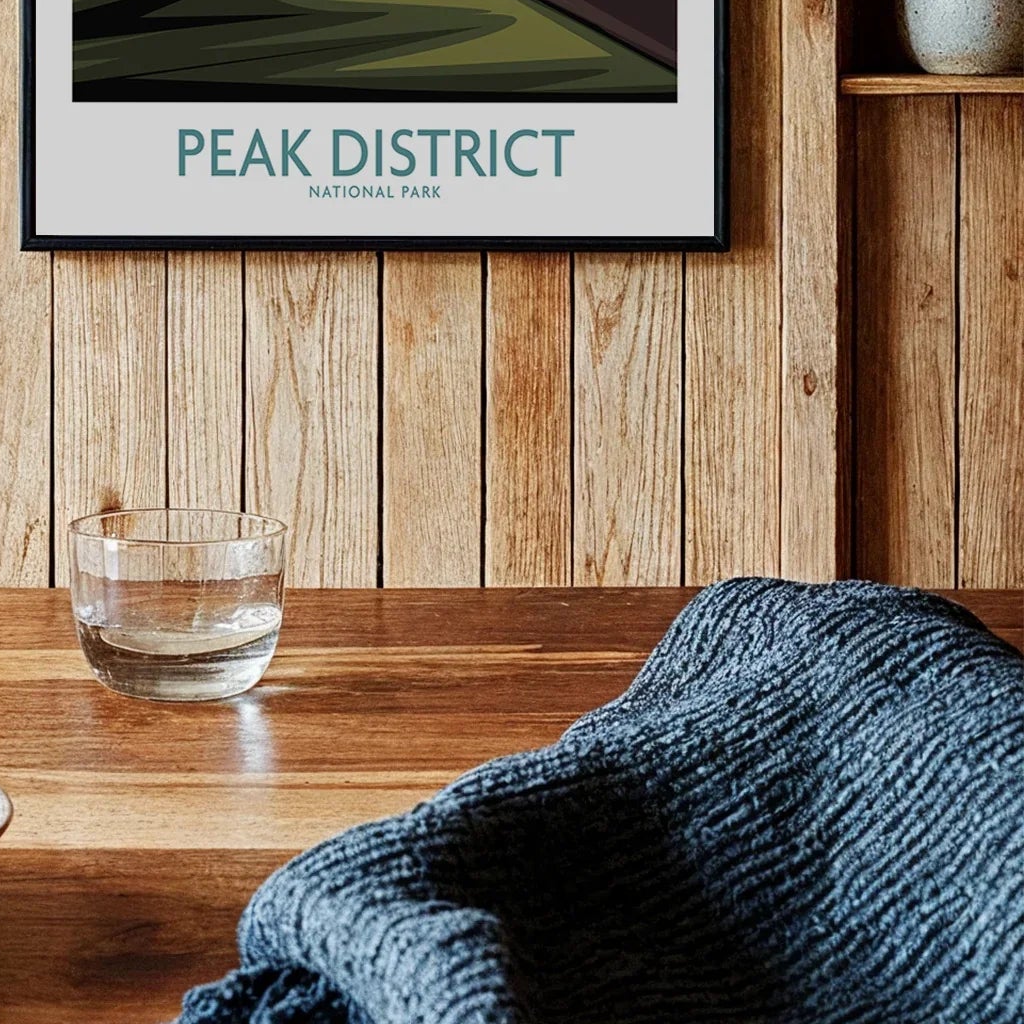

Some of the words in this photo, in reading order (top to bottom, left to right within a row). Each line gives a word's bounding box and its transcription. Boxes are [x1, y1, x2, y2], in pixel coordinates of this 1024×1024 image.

[177, 128, 313, 177] PEAK
[331, 128, 576, 178] DISTRICT
[308, 184, 395, 199] NATIONAL
[401, 184, 441, 199] PARK
